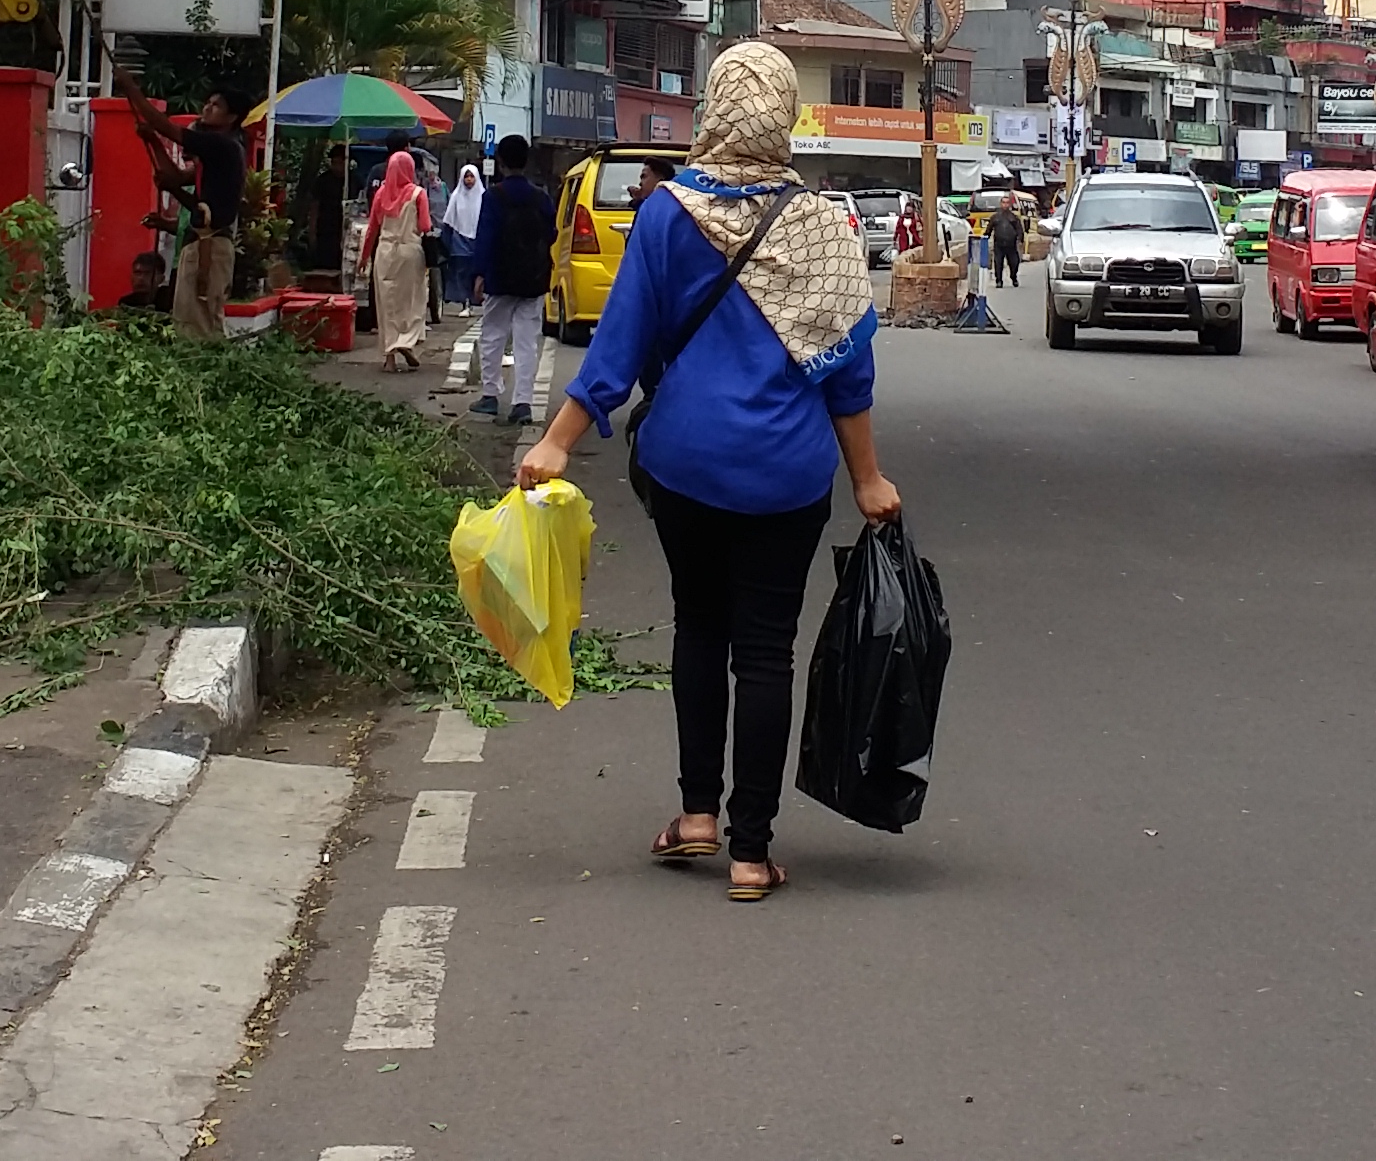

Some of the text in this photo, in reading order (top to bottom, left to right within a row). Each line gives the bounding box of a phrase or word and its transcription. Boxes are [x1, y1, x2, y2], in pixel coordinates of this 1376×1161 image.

[545, 86, 595, 120] SAMSUNG
[487, 129, 493, 150] P
[794, 140, 814, 150] Toko
[1123, 144, 1135, 160] P
[1303, 153, 1313, 169] P
